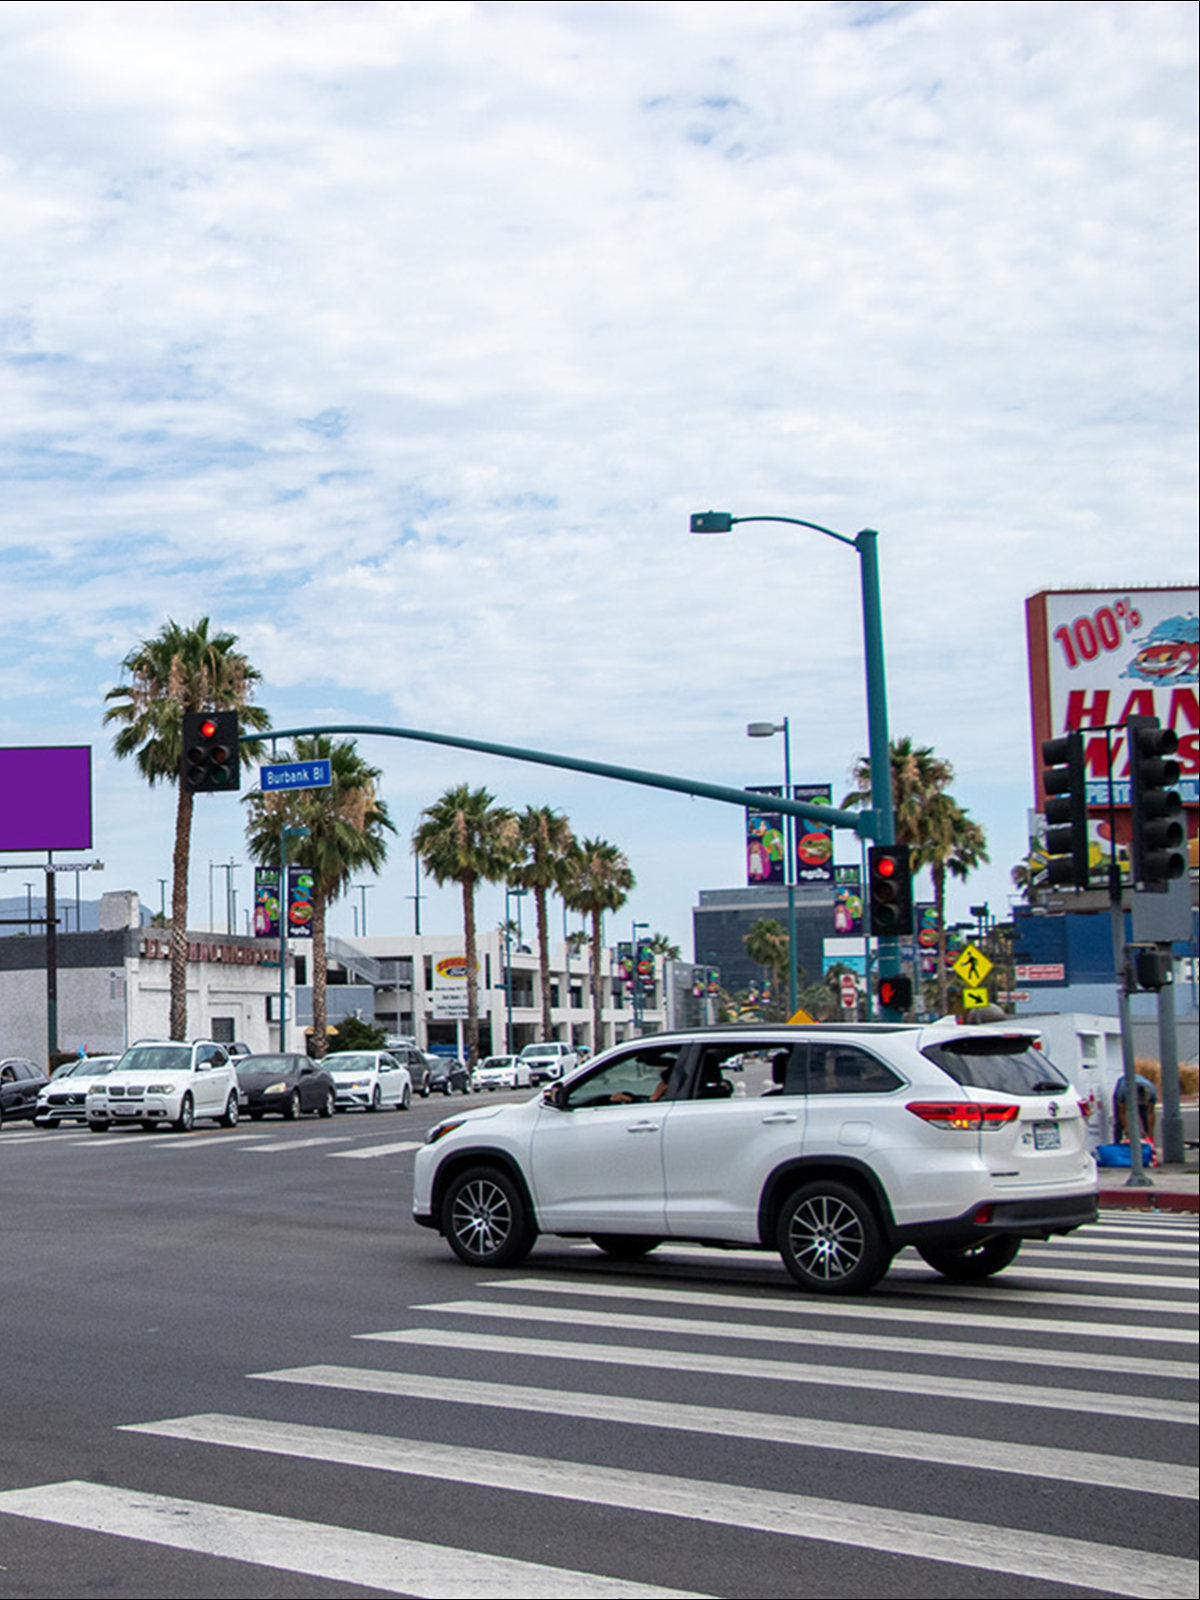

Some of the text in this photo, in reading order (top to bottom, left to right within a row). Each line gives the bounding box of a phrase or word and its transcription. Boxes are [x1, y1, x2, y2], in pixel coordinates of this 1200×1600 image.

[1054, 597, 1141, 669] 100%
[267, 766, 325, 785] Burbank Bl
